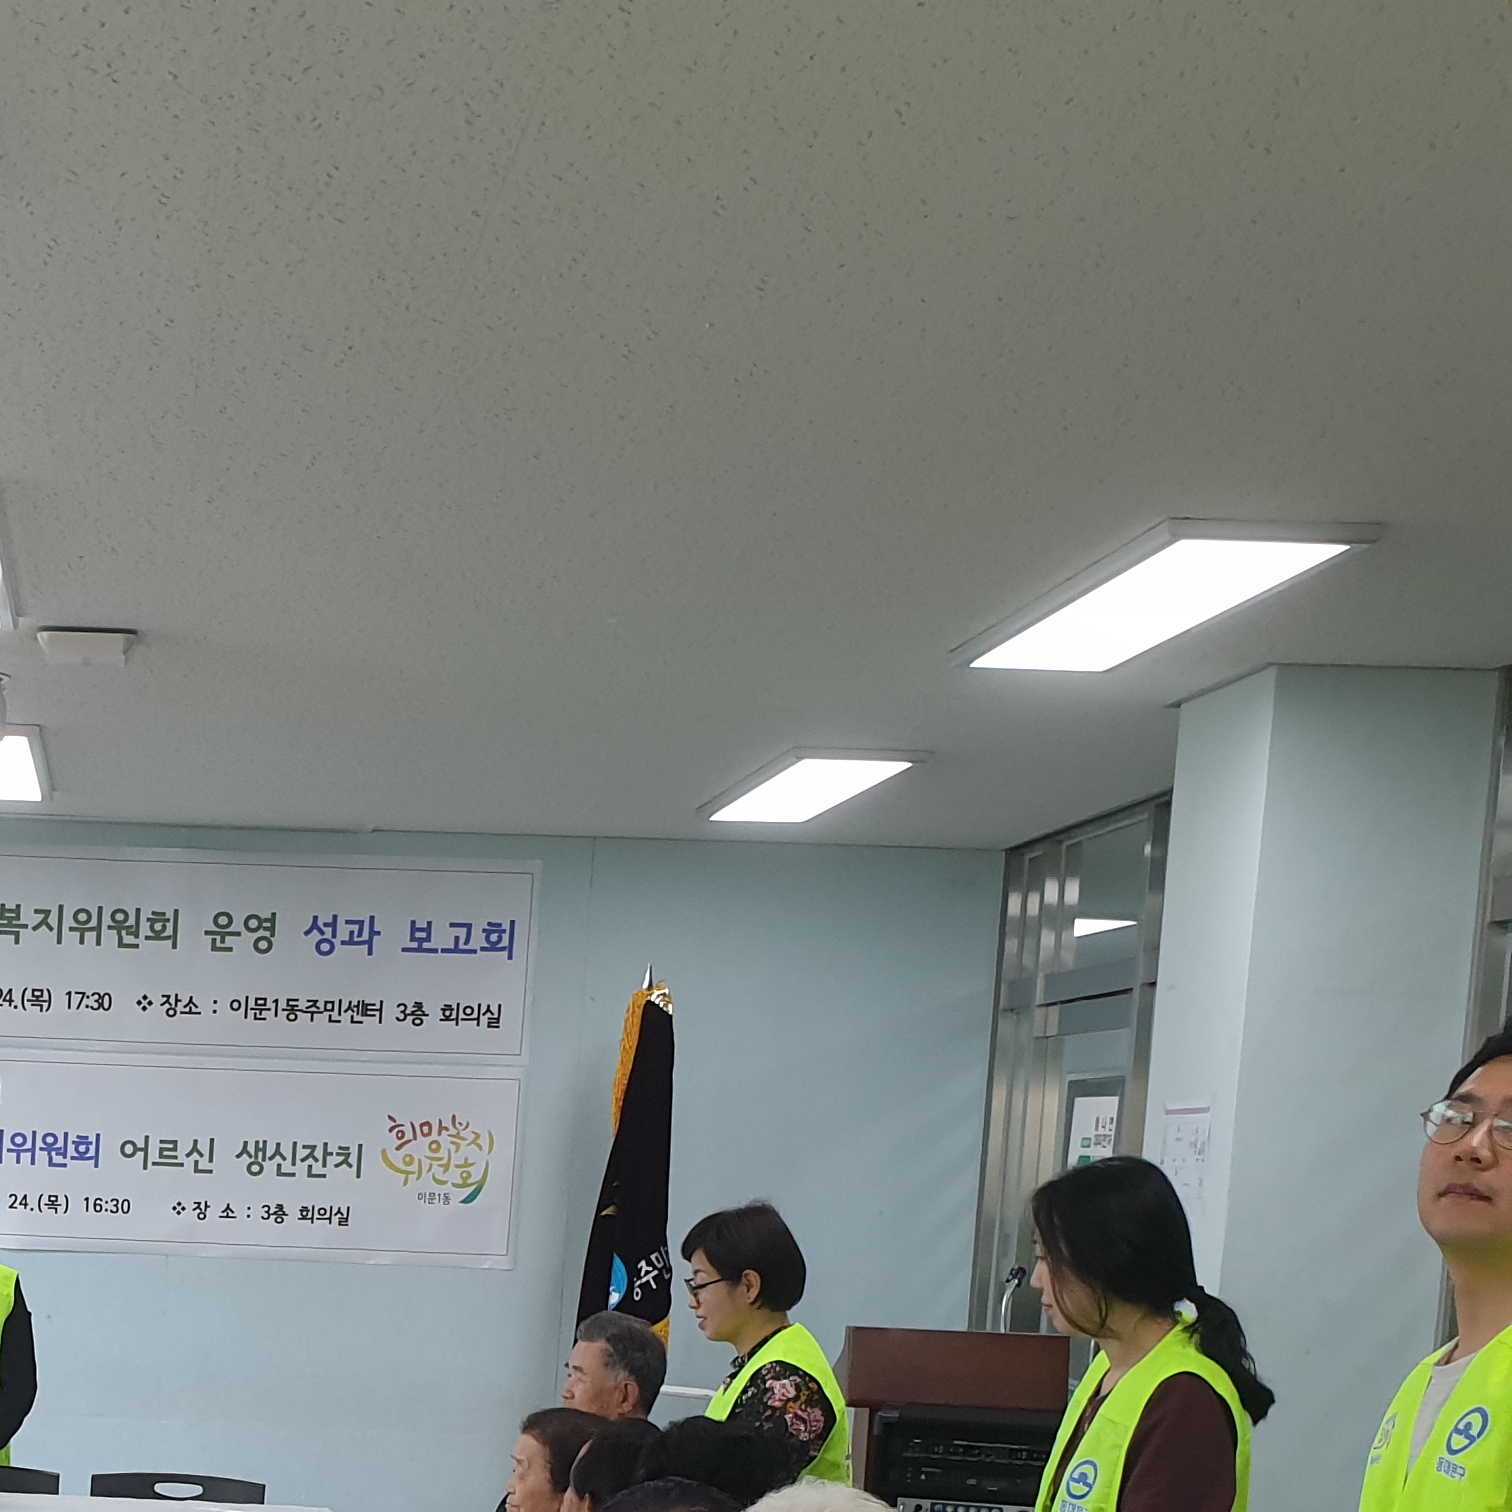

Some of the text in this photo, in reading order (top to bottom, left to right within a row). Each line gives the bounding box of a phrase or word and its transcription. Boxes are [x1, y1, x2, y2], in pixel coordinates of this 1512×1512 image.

[203, 911, 277, 955] 운영
[303, 913, 382, 957] 성과
[400, 919, 516, 961] 보고회
[64, 990, 113, 1012] 17:30
[159, 992, 202, 1019] 장소
[229, 995, 384, 1025] 이문1동주민센터
[394, 1000, 430, 1027] 3층
[438, 1001, 502, 1029] 회의실
[119, 1134, 216, 1175] 어르신
[234, 1138, 364, 1180] 생신잔치
[83, 1196, 131, 1215] 16:30
[260, 1203, 290, 1225] 3층
[297, 1204, 351, 1227] 회의실
[417, 1192, 452, 1206] 이문1동
